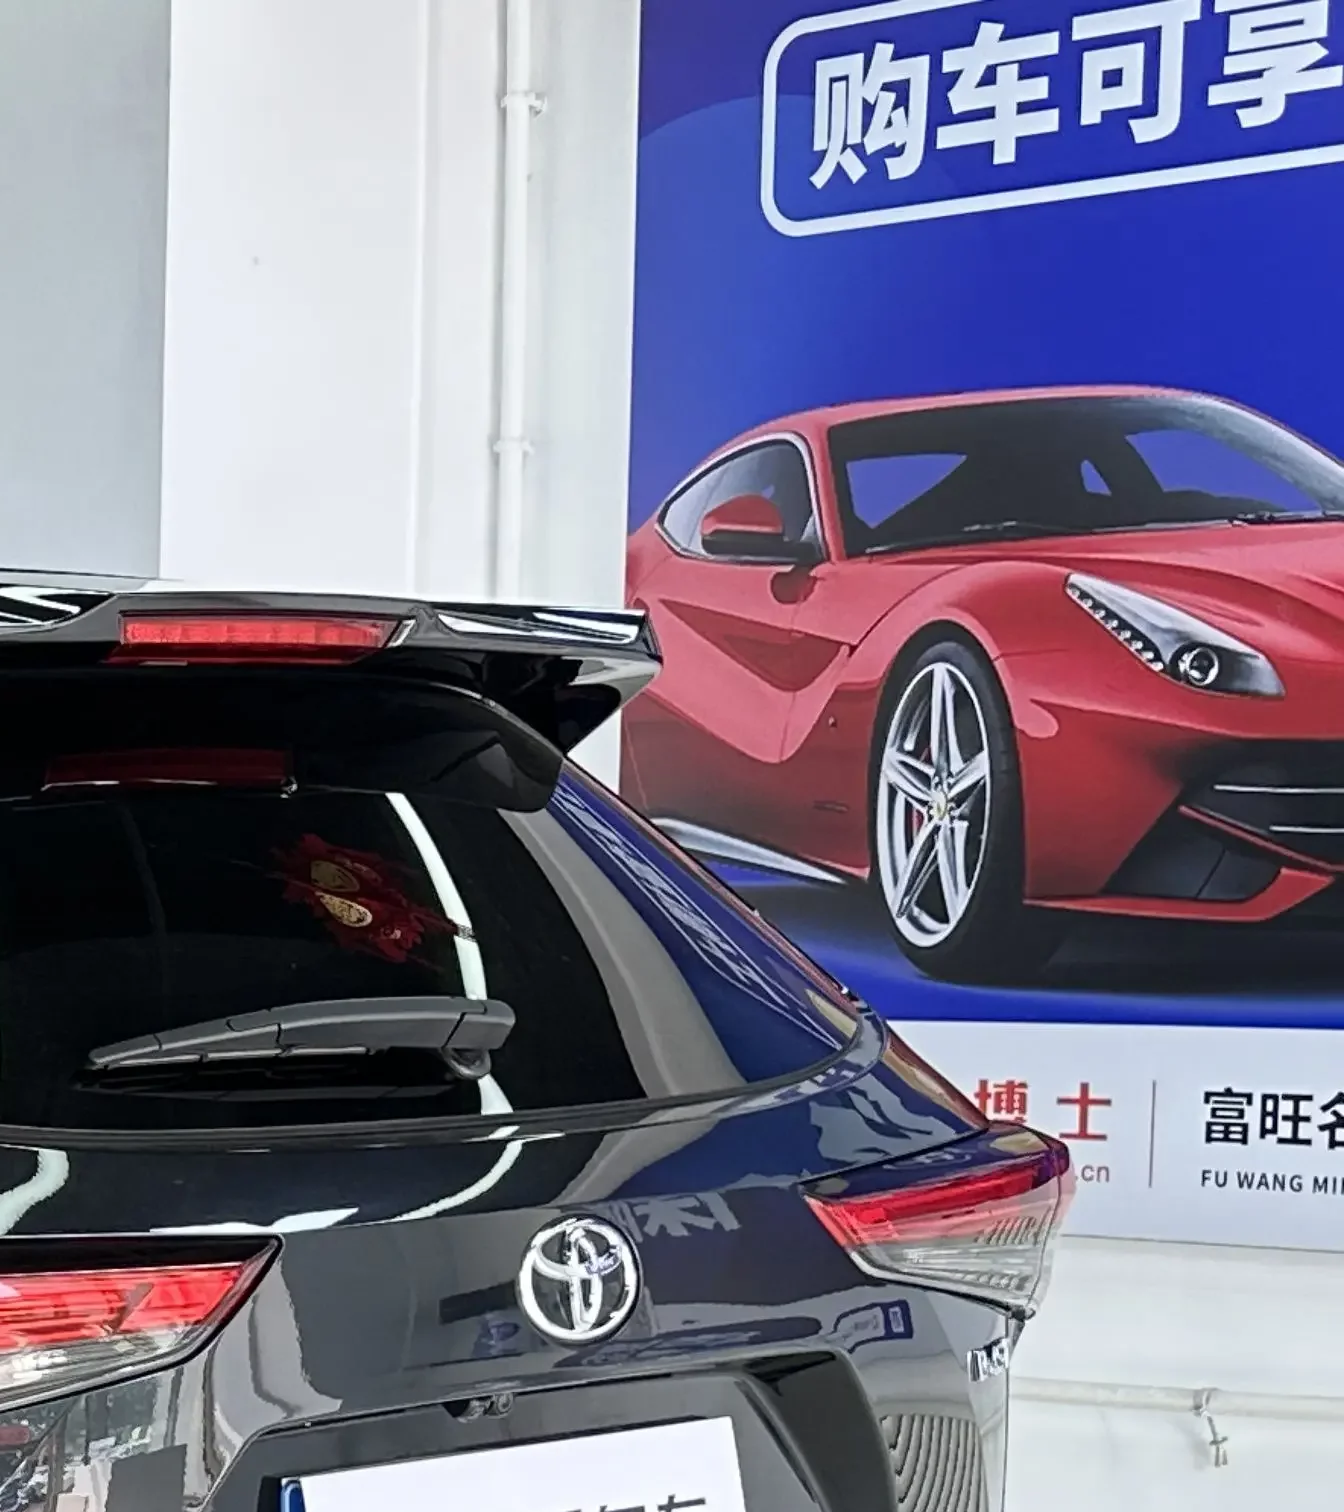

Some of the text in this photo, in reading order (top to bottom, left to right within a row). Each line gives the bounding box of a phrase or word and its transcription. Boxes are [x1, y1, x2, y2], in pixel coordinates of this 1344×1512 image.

[809, 0, 1344, 190] 购车可享
[1201, 1169, 1344, 1196] FU WANG MI
